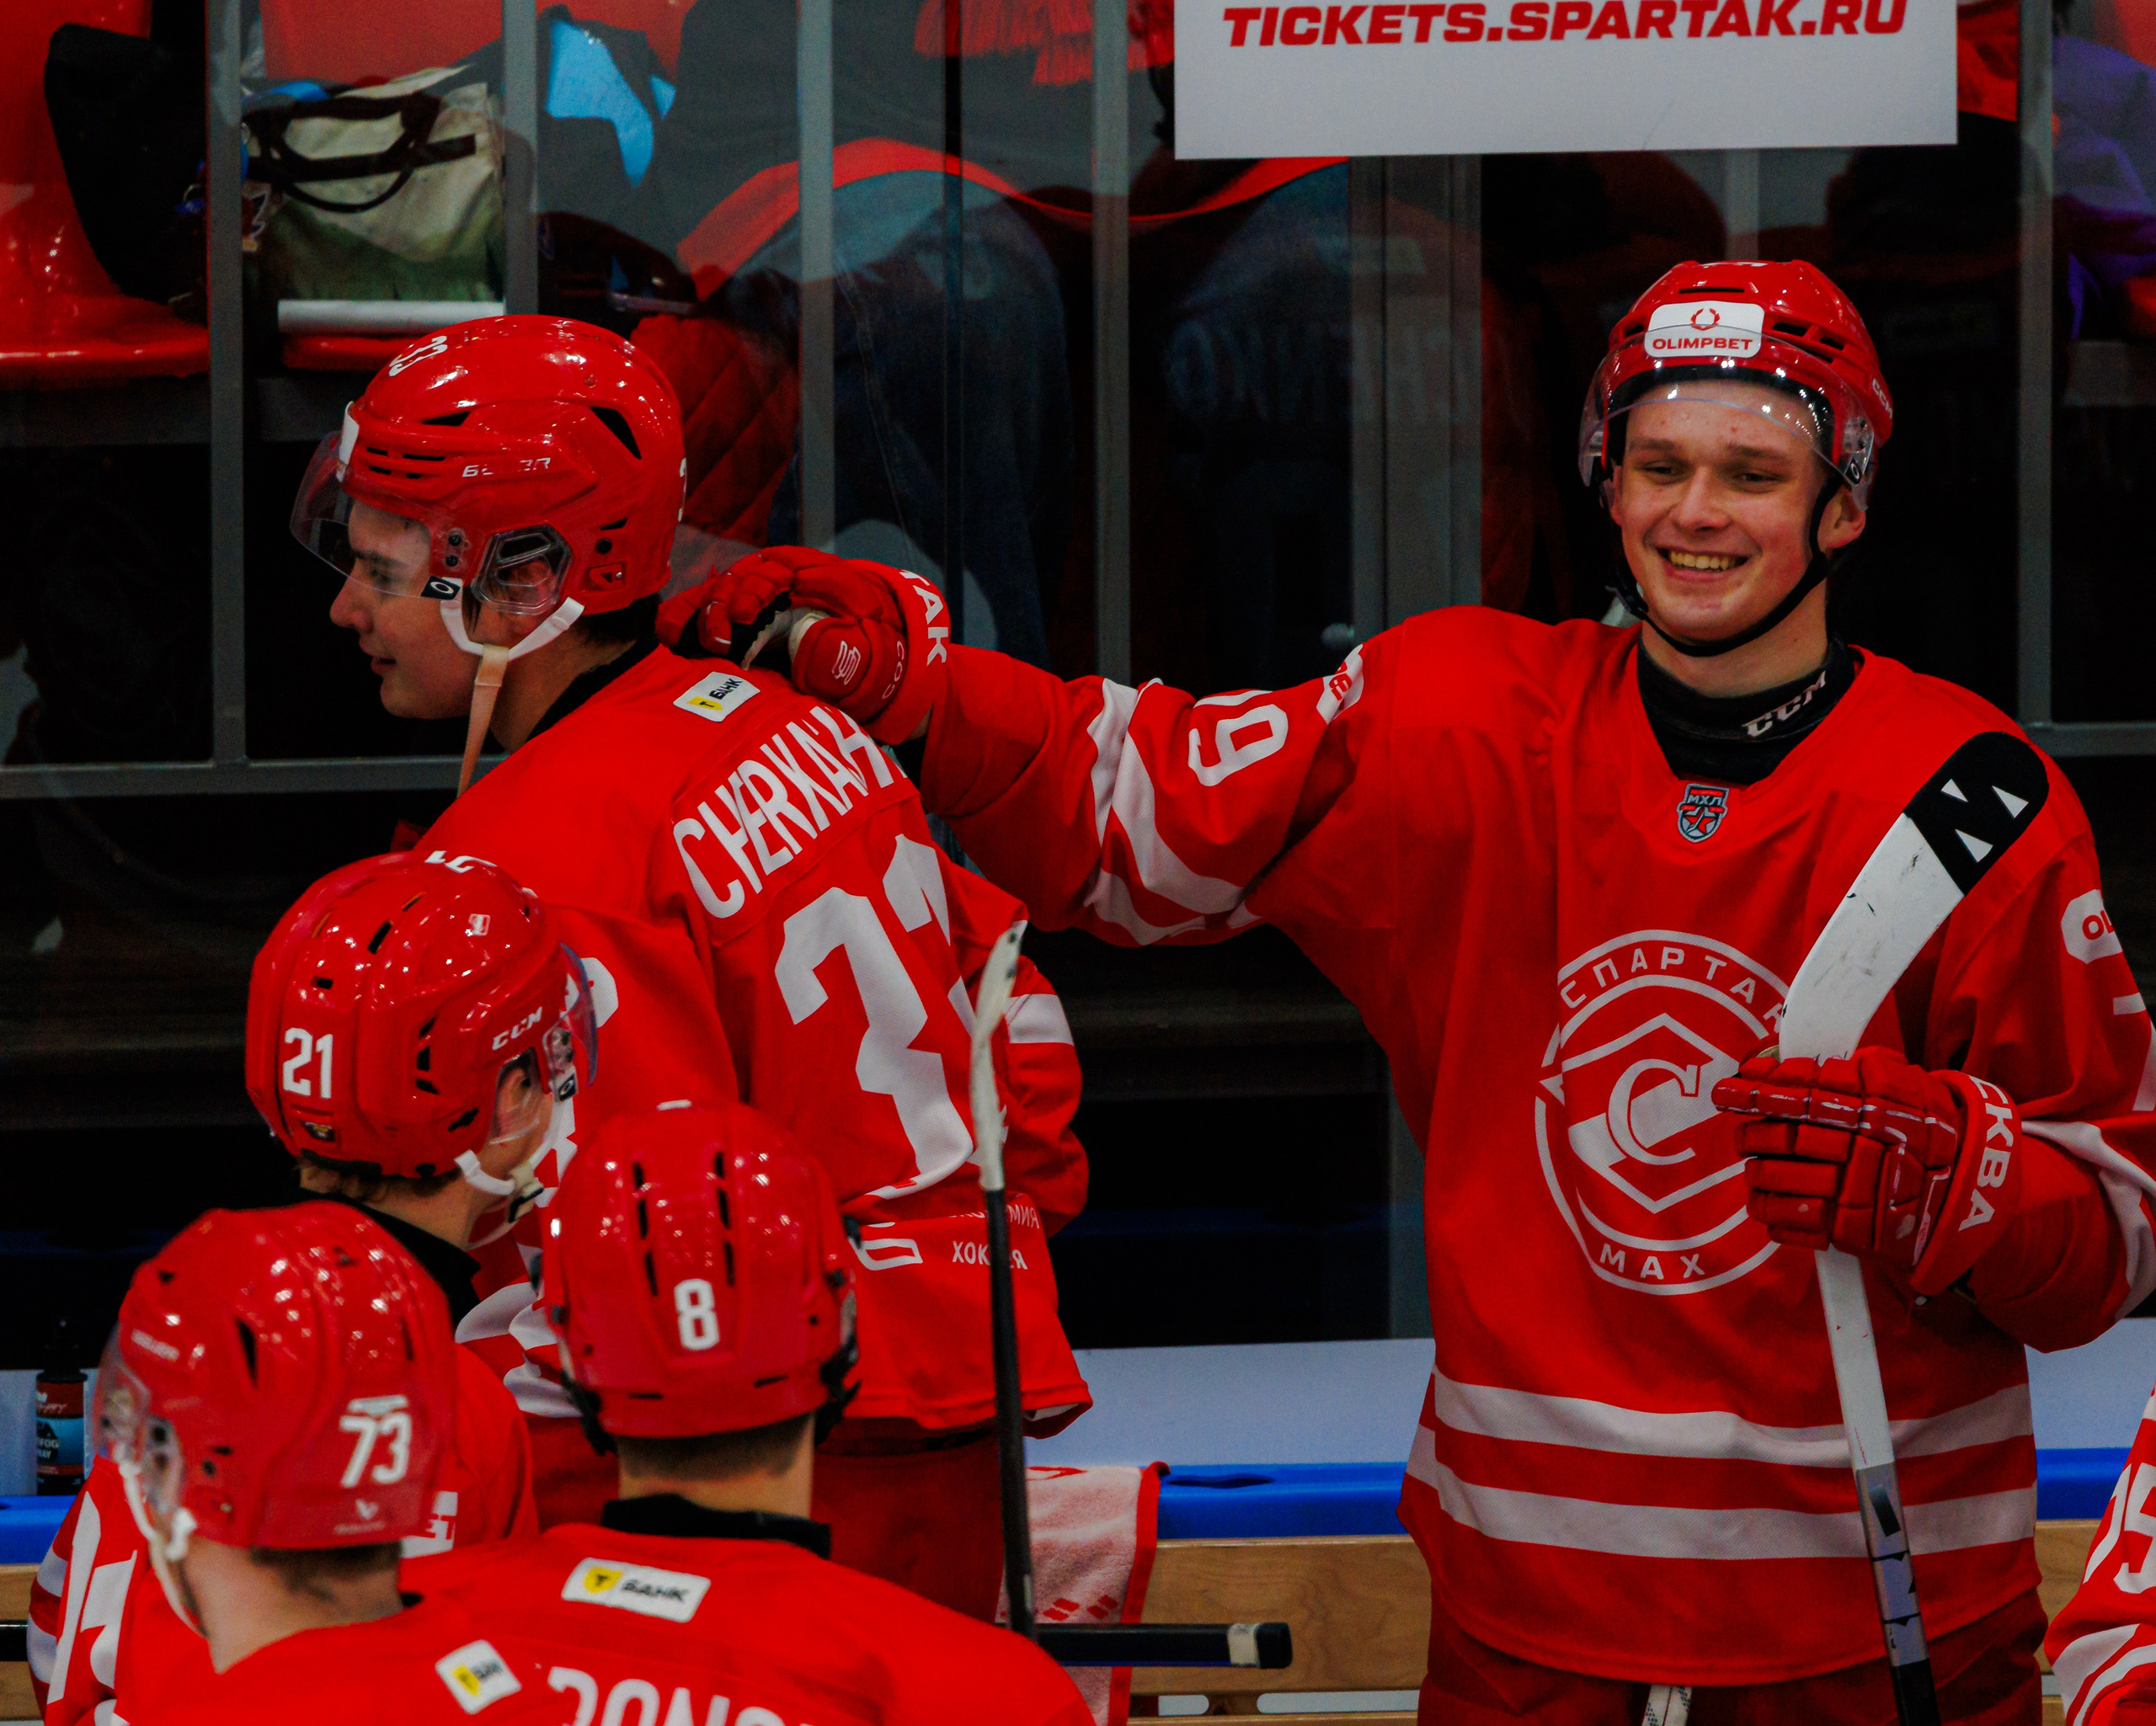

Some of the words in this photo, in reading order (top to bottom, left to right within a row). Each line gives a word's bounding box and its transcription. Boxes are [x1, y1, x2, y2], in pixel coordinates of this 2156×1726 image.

[1223, 0, 1907, 47] TICKETS.SPARTAK.RU
[1652, 337, 1753, 351] OLIMPBET
[1741, 670, 1826, 738] CCM
[1687, 794, 1723, 807] МХЛ
[492, 1006, 543, 1052] CCM
[283, 1027, 334, 1100] 21
[674, 1277, 720, 1350] 8
[339, 1411, 413, 1489] 73
